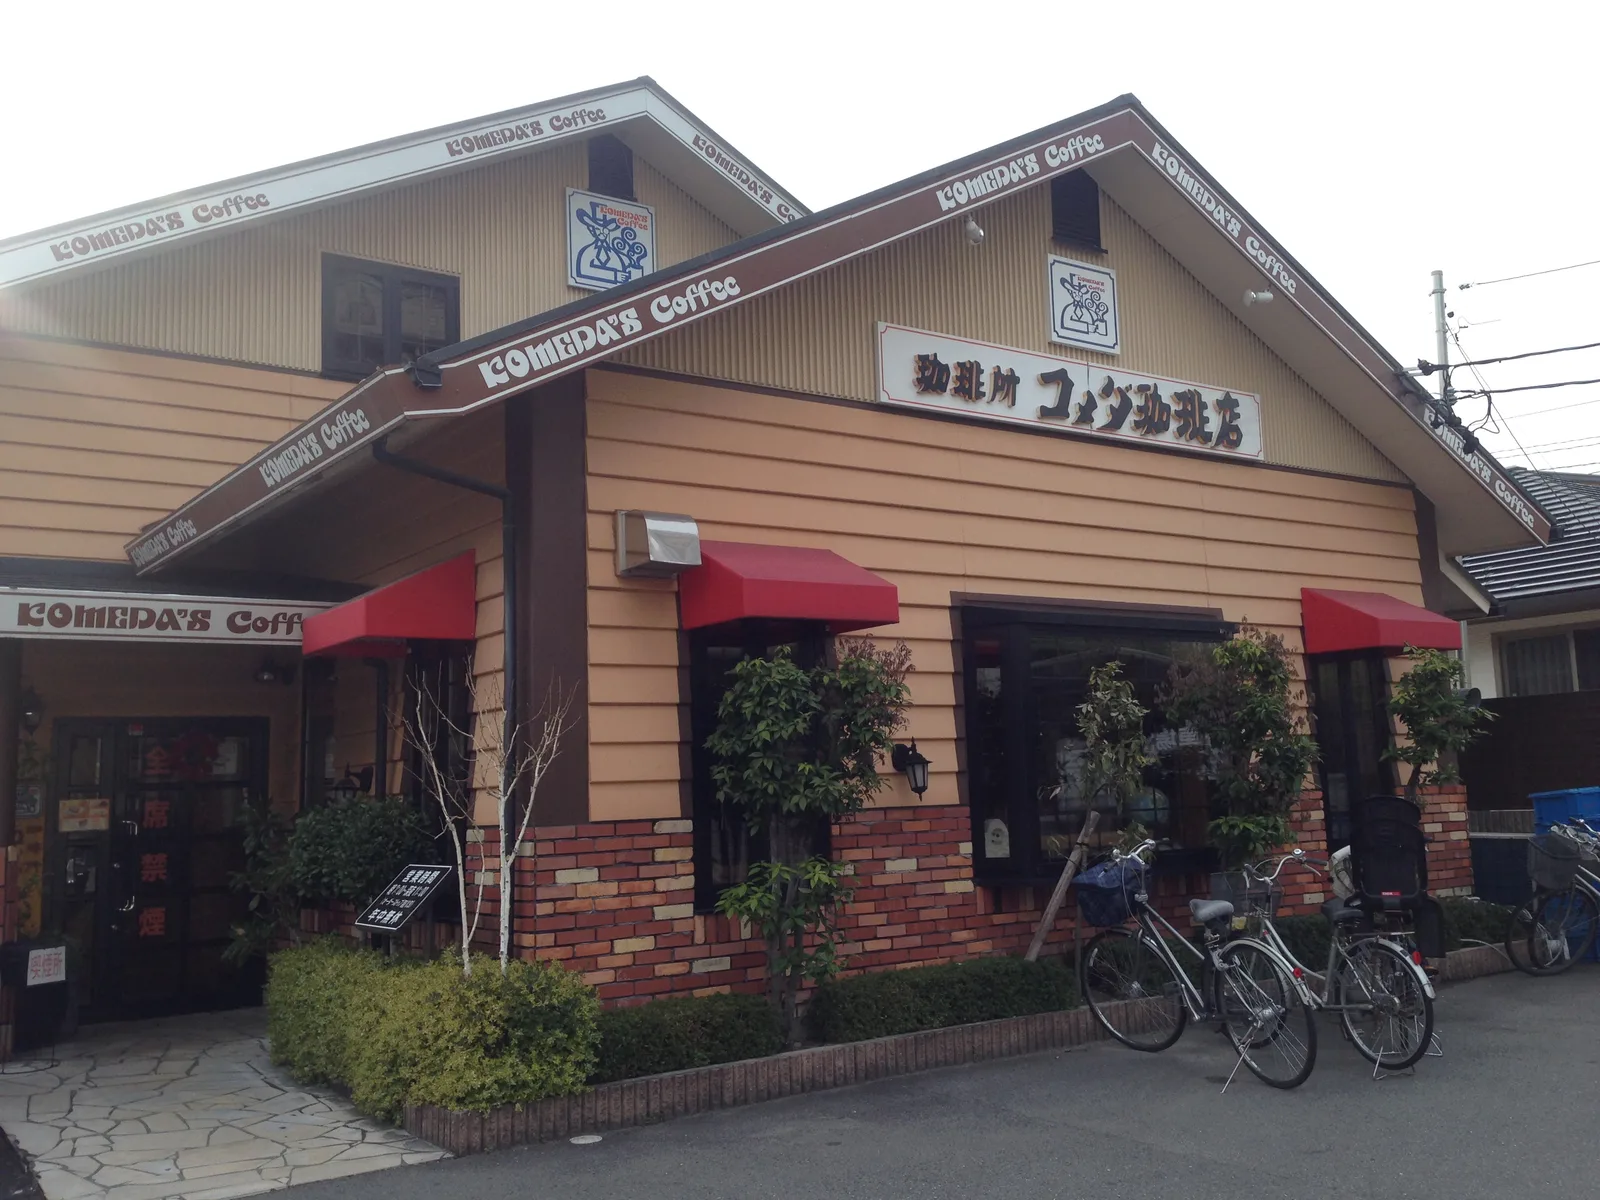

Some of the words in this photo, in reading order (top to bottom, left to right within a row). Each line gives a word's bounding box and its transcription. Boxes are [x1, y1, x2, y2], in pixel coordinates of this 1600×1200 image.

[445, 120, 544, 157] KOMEDA'S
[549, 108, 607, 132] Coffee
[692, 134, 773, 205] KOMEDA'S
[936, 153, 1040, 211] KOMEDA'S
[1044, 134, 1105, 168] Coffee
[50, 211, 185, 262] KOMEDA'S
[192, 193, 270, 223] Coffee
[617, 217, 648, 231] Coffee
[1152, 142, 1242, 238] KOMEDA'S
[1245, 236, 1297, 294] Coffee
[478, 307, 642, 389] KOMEDA'S
[650, 276, 741, 323] Coffee
[911, 352, 1020, 408] 珈琲所
[1036, 368, 1244, 449] コメダ珈琲店
[258, 432, 323, 487] KOMEDA'S
[320, 408, 370, 450] Coffee
[1495, 480, 1535, 528] Coffee
[17, 602, 211, 632] KOMEDA'S
[226, 610, 303, 635] Coff
